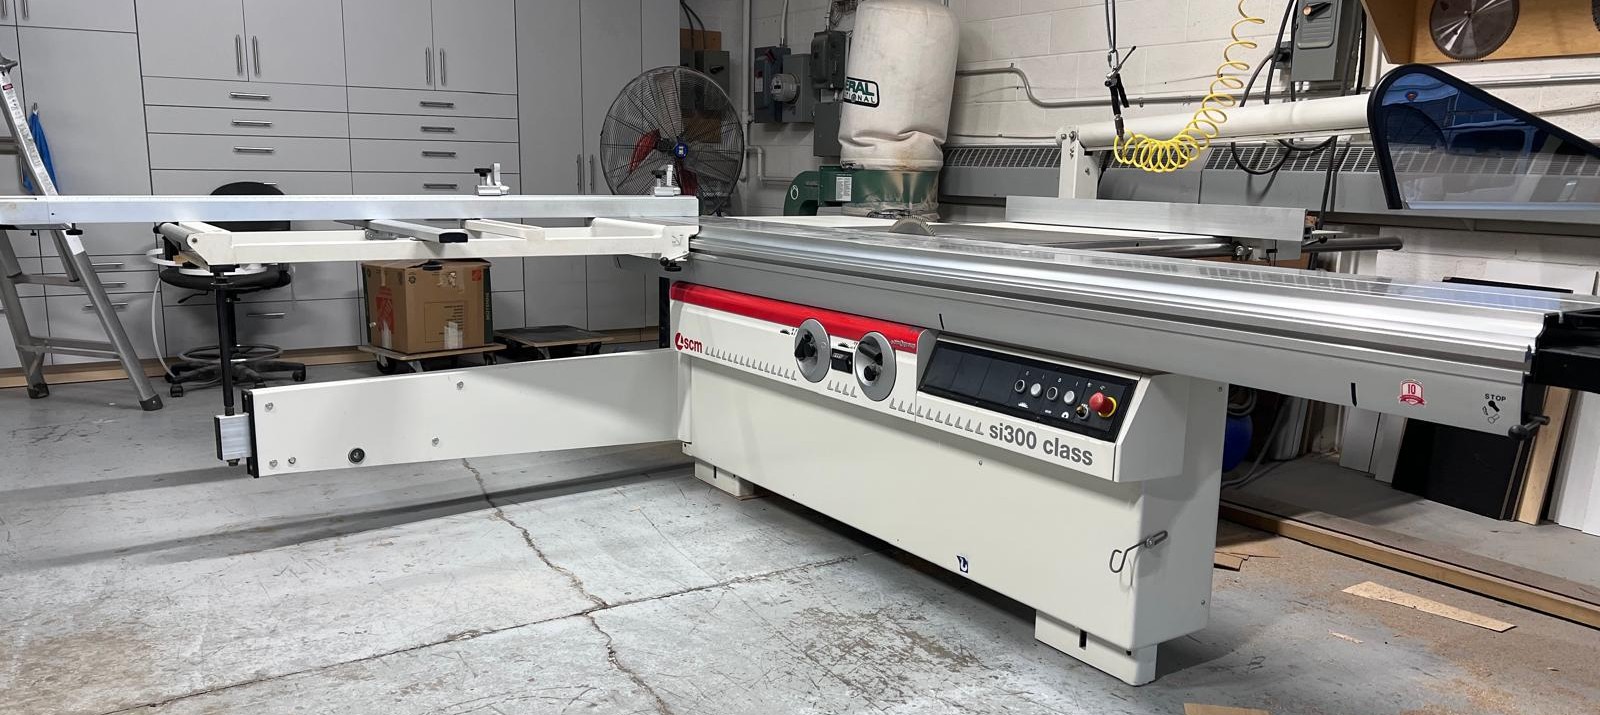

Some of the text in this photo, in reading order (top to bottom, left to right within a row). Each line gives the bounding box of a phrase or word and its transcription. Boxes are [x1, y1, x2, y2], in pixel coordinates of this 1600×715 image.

[683, 338, 703, 353] scm
[1407, 383, 1416, 394] 10
[1485, 393, 1506, 402] STOP
[989, 423, 1093, 466] si300 class
